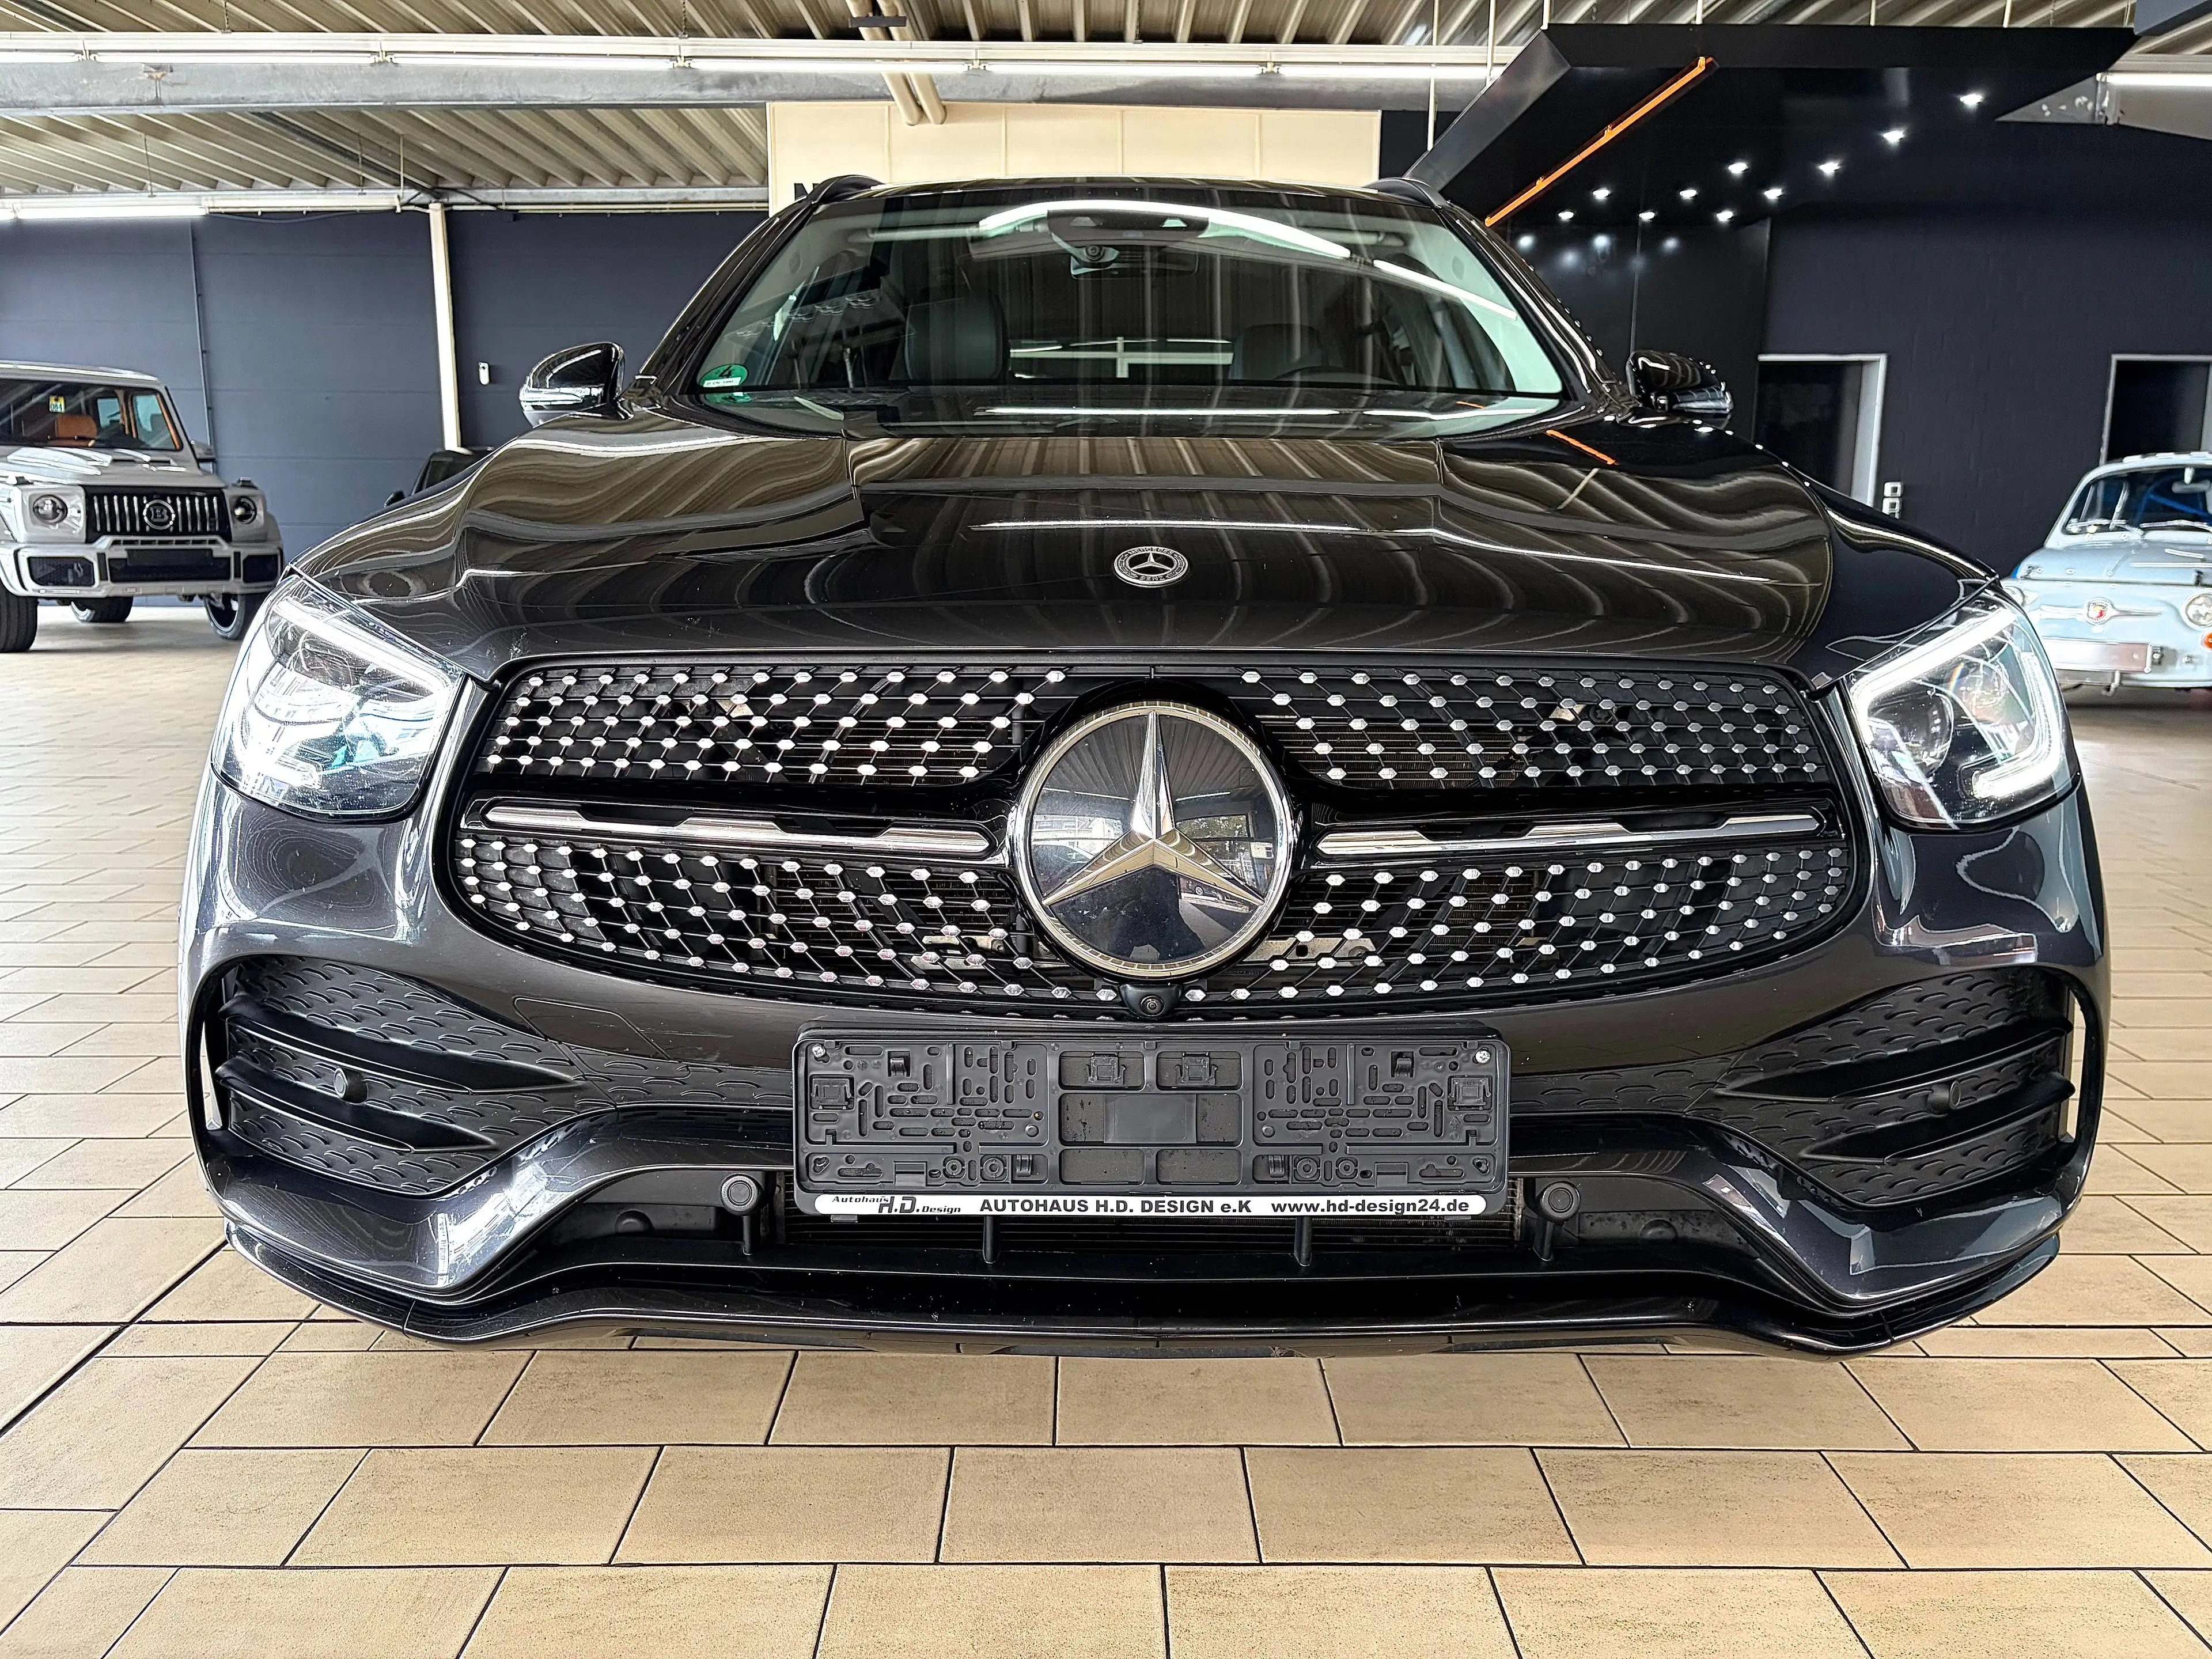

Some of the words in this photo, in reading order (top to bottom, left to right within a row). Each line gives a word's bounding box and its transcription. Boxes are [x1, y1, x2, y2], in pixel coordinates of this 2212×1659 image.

[719, 365, 733, 378] 4
[980, 1199, 1089, 1212] AUTOHAUS
[1096, 1199, 1134, 1213] H.D.
[1141, 1199, 1214, 1213] DESIGN
[1220, 1199, 1252, 1213] e.K
[1271, 1199, 1469, 1215] www.hd-design24.de
